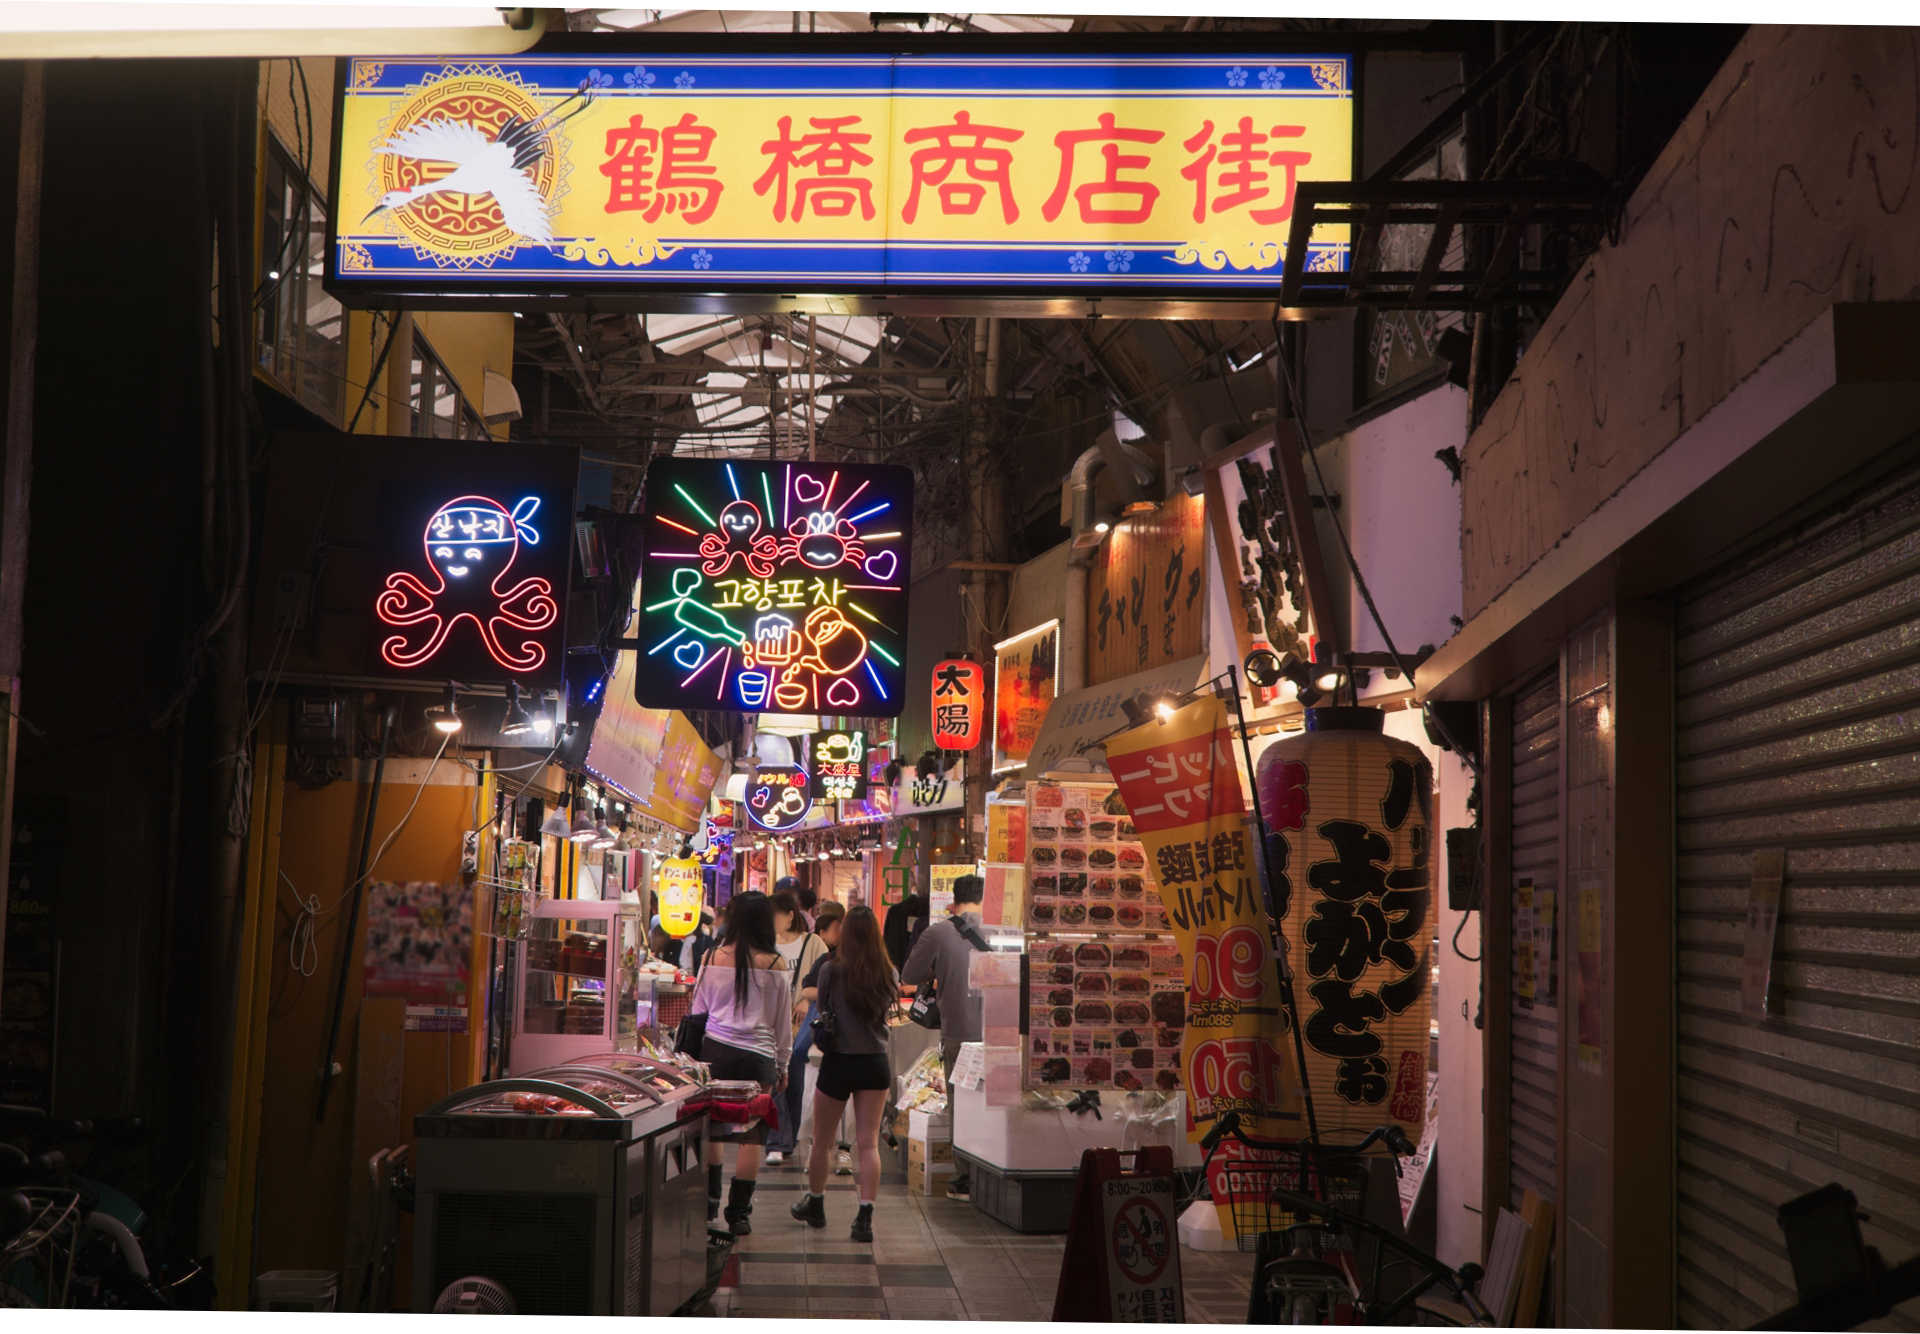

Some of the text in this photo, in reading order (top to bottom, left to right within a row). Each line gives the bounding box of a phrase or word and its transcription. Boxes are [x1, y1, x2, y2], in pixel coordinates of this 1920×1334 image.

[599, 111, 1312, 225] 鶴橋商店街
[431, 511, 505, 541] 산낙지
[712, 577, 848, 611] 고향포차
[935, 664, 972, 737] 太陽
[816, 761, 862, 777] 大盛屋
[1153, 1220, 1165, 1258] 위험
